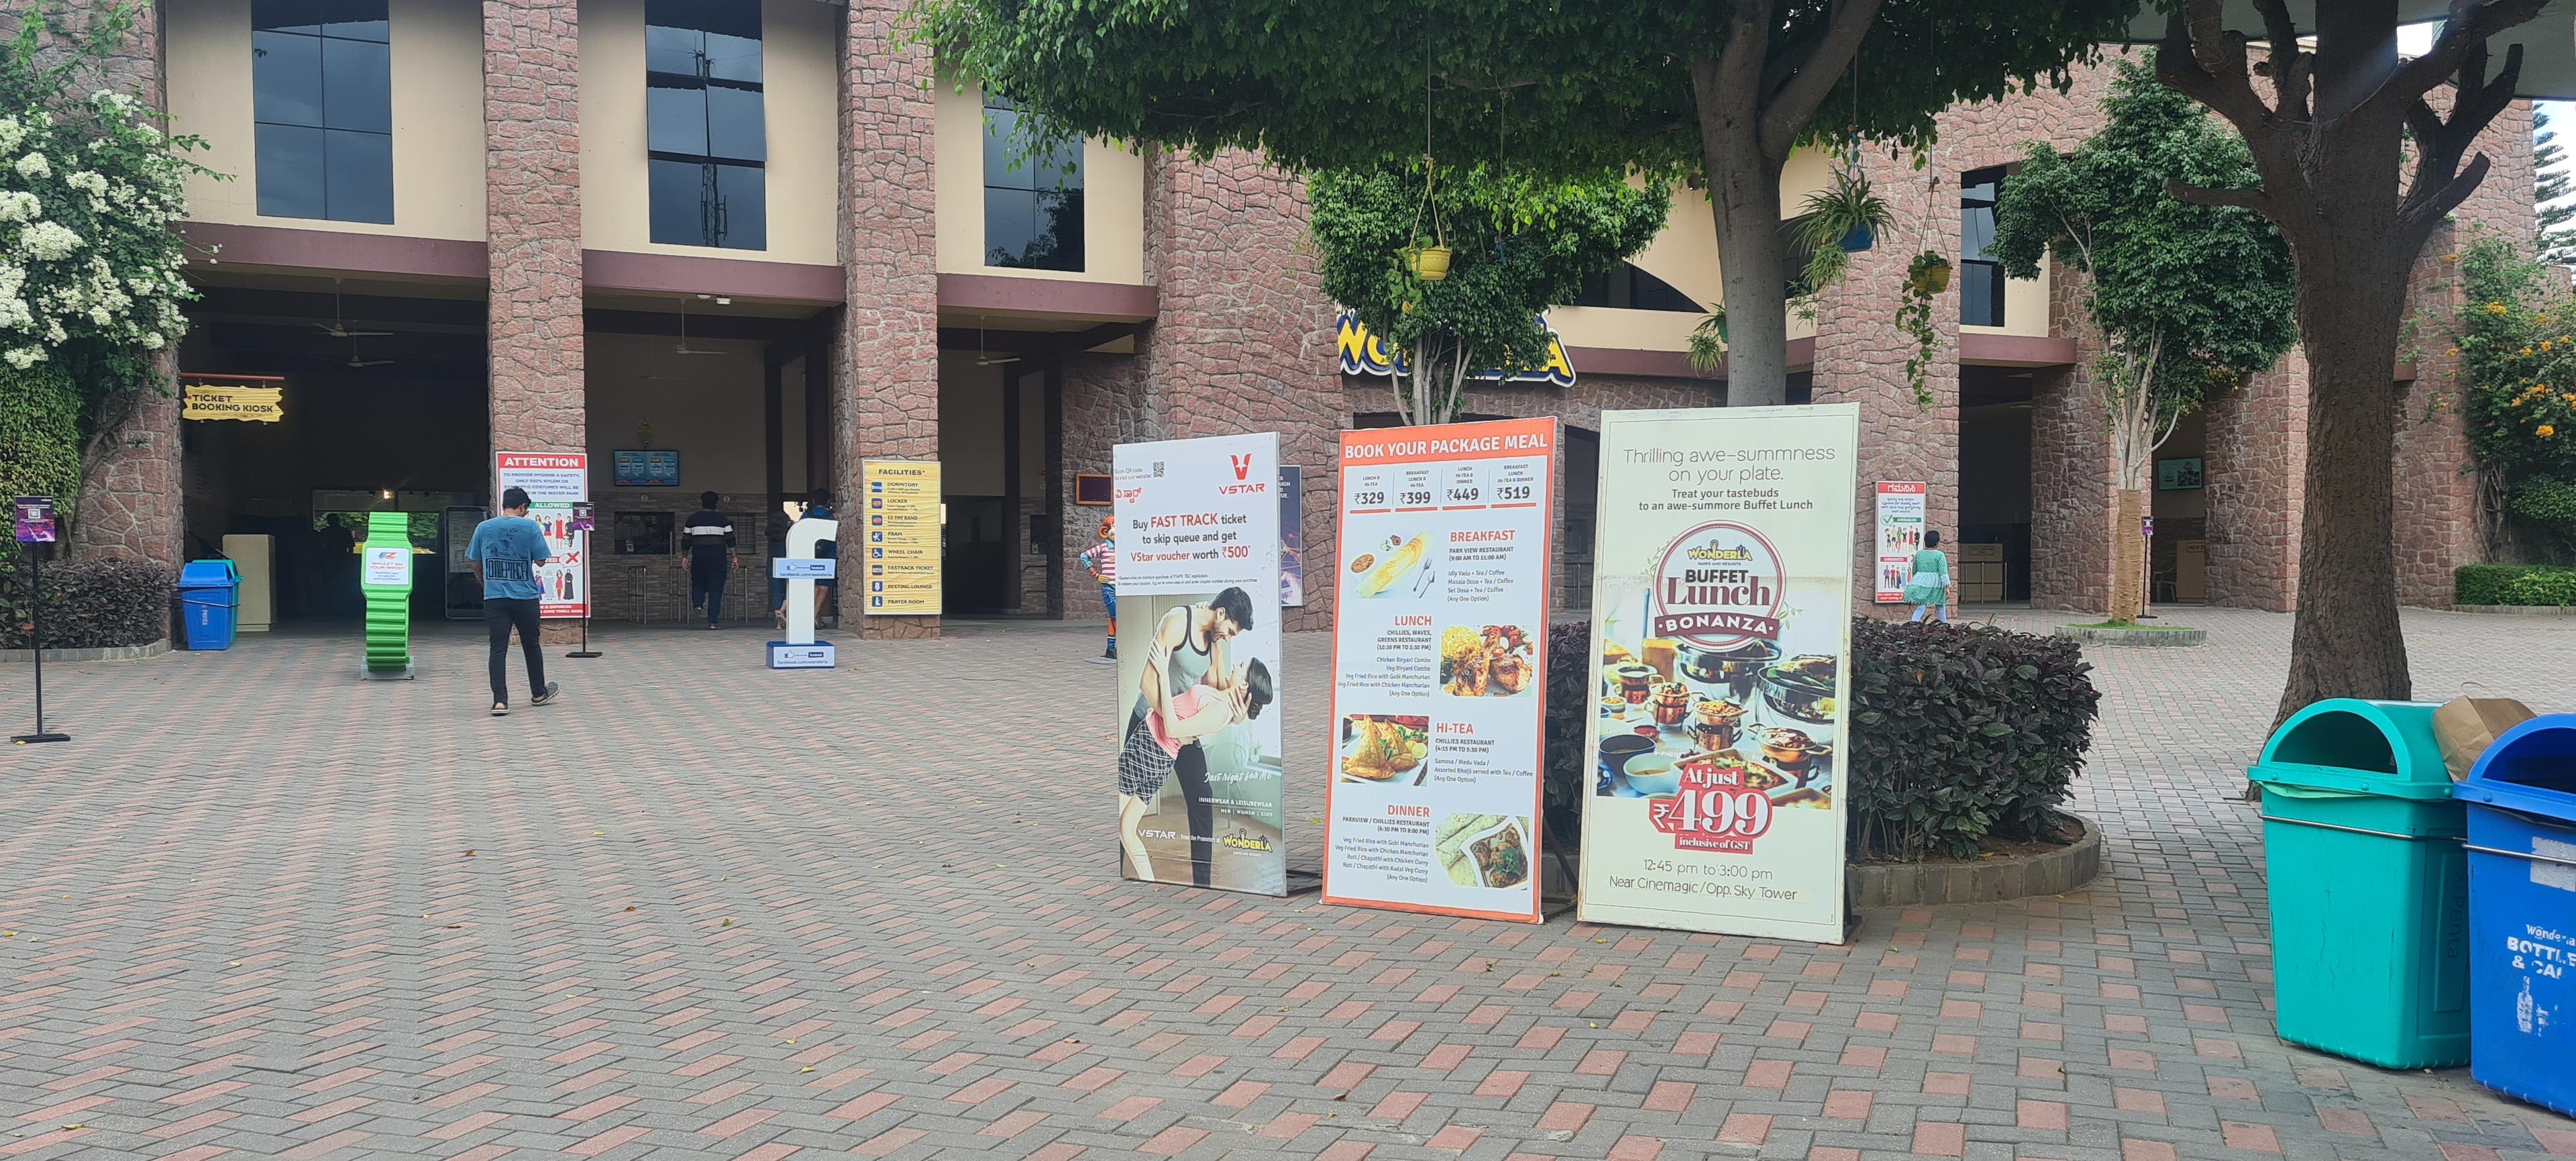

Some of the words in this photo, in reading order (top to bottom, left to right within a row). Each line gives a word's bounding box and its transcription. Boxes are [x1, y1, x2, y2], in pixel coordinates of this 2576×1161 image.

[192, 403, 240, 411] BOOKING
[1345, 444, 1385, 458] BOOK
[1387, 440, 1427, 456] YOUR
[1431, 436, 1500, 454] PACKAGE
[1505, 433, 1548, 450] MEAL
[504, 458, 578, 466] ATTENTION
[1623, 448, 1684, 466] Thrilling
[1669, 470, 1690, 482] on
[1697, 468, 1734, 485] your
[1739, 466, 1783, 485] plate.
[1219, 483, 1265, 495] VSTAR
[1446, 487, 1479, 501] ₹449
[1497, 486, 1530, 499] ₹519
[1672, 489, 1697, 499] Treat
[1701, 490, 1724, 500] your
[1727, 488, 1779, 498] tastebuds
[1354, 491, 1385, 505] ₹329
[1399, 491, 1431, 505] ₹399
[1639, 502, 1649, 511] to
[1667, 502, 1740, 511] awe-summore
[1743, 500, 1777, 509] Buffet
[1780, 499, 1813, 509] Lunch
[1133, 519, 1148, 531] Buy
[1150, 515, 1177, 528] FAST
[1180, 513, 1218, 526] TRACK
[1221, 514, 1246, 524] ticket
[1142, 535, 1151, 544] to
[1154, 533, 1171, 546] skip
[1173, 534, 1200, 547] queue
[1202, 531, 1218, 542] and
[1221, 531, 1236, 544] get
[1450, 529, 1515, 542] BREAKFAST
[1131, 551, 1153, 562] VStar
[1157, 549, 1190, 561] voucher
[1192, 548, 1219, 560] worth
[1688, 544, 1753, 561] WONDERLA
[1684, 570, 1749, 583] BUFFET
[1665, 576, 1772, 606] Lunch
[1395, 615, 1432, 626] LUNCH
[1665, 614, 1768, 634] BONANZA
[1436, 723, 1474, 734] HI-TEA
[1203, 772, 1222, 783] Just
[1222, 772, 1244, 784] right
[1245, 771, 1258, 781] for
[1684, 767, 1704, 785] At
[1703, 768, 1739, 789] just
[1387, 805, 1430, 817] DINNER
[1653, 789, 1768, 836] ₹499
[1138, 829, 1176, 840] VSTAR
[1224, 832, 1273, 852] WONDERLA
[1679, 836, 1719, 848] inclusive
[1719, 839, 1731, 849] of
[1730, 840, 1750, 851] GST
[1644, 859, 1672, 872] 12:45
[1677, 863, 1698, 875] pm
[1703, 863, 1716, 876] to
[1719, 865, 1748, 878] 3:00
[1752, 868, 1773, 881] pm
[1609, 876, 1635, 889] Near
[1734, 885, 1755, 899] Sky
[1759, 887, 1797, 900] Tower
[2512, 955, 2524, 969] &
